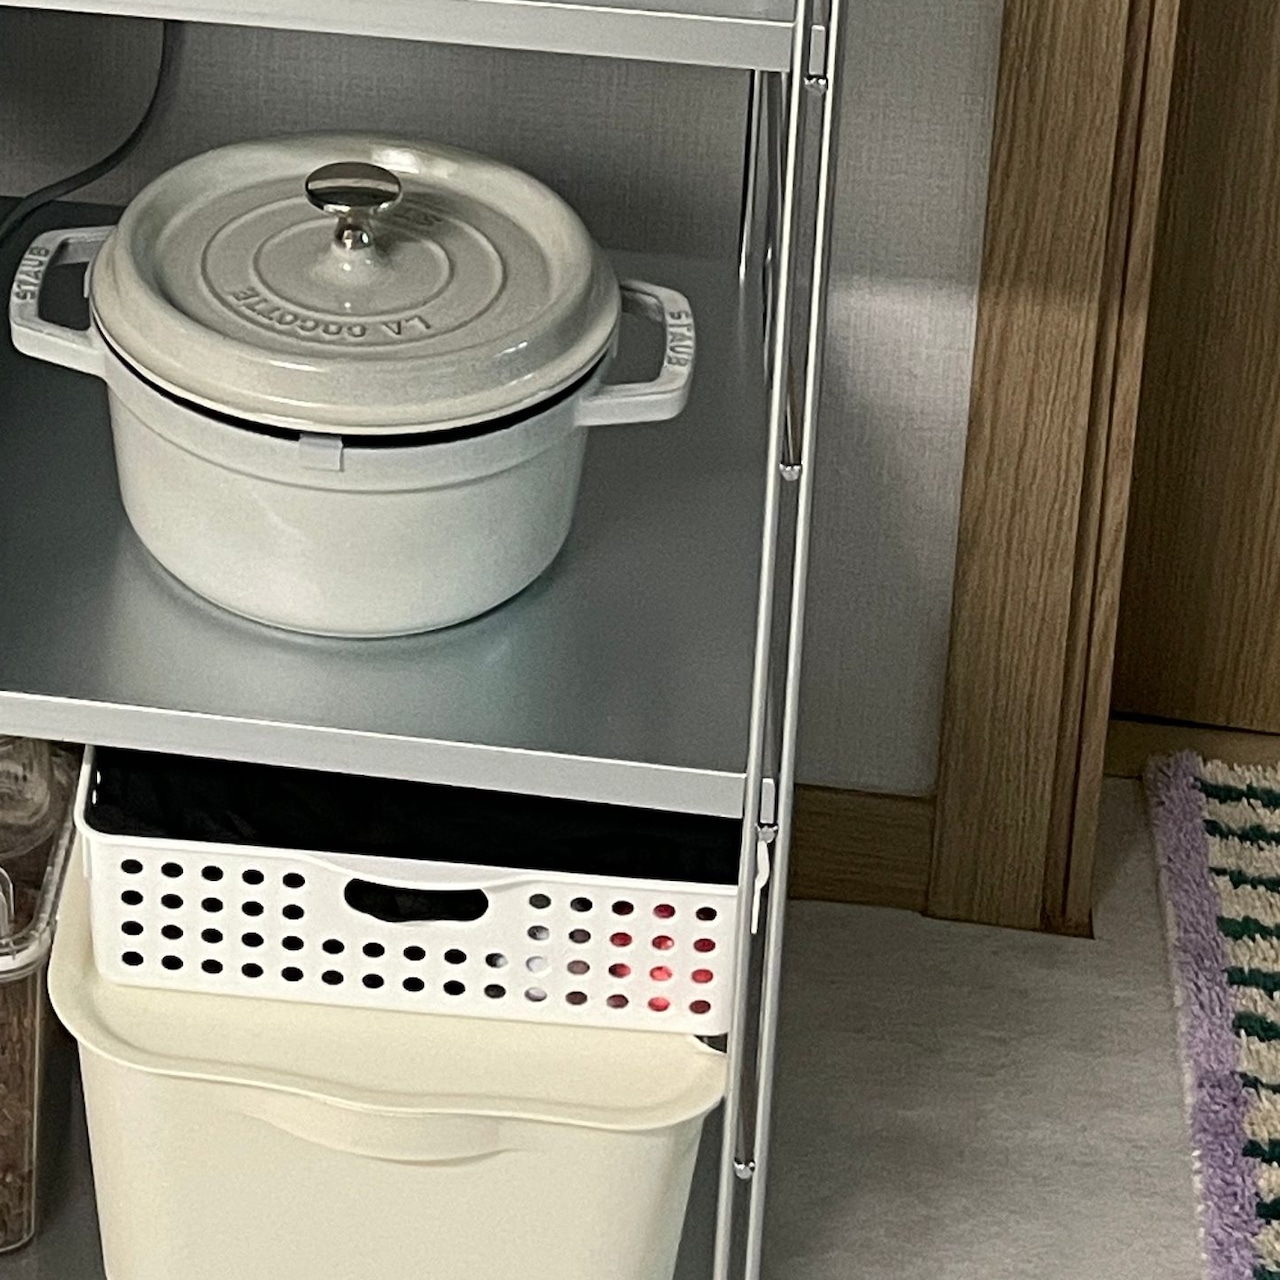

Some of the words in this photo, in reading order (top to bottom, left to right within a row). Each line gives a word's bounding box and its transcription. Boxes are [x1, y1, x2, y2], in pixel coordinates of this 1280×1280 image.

[15, 246, 50, 300] STAUB
[231, 287, 367, 338] COCOTTE
[381, 314, 431, 336] LA
[667, 311, 693, 367] STAUB
